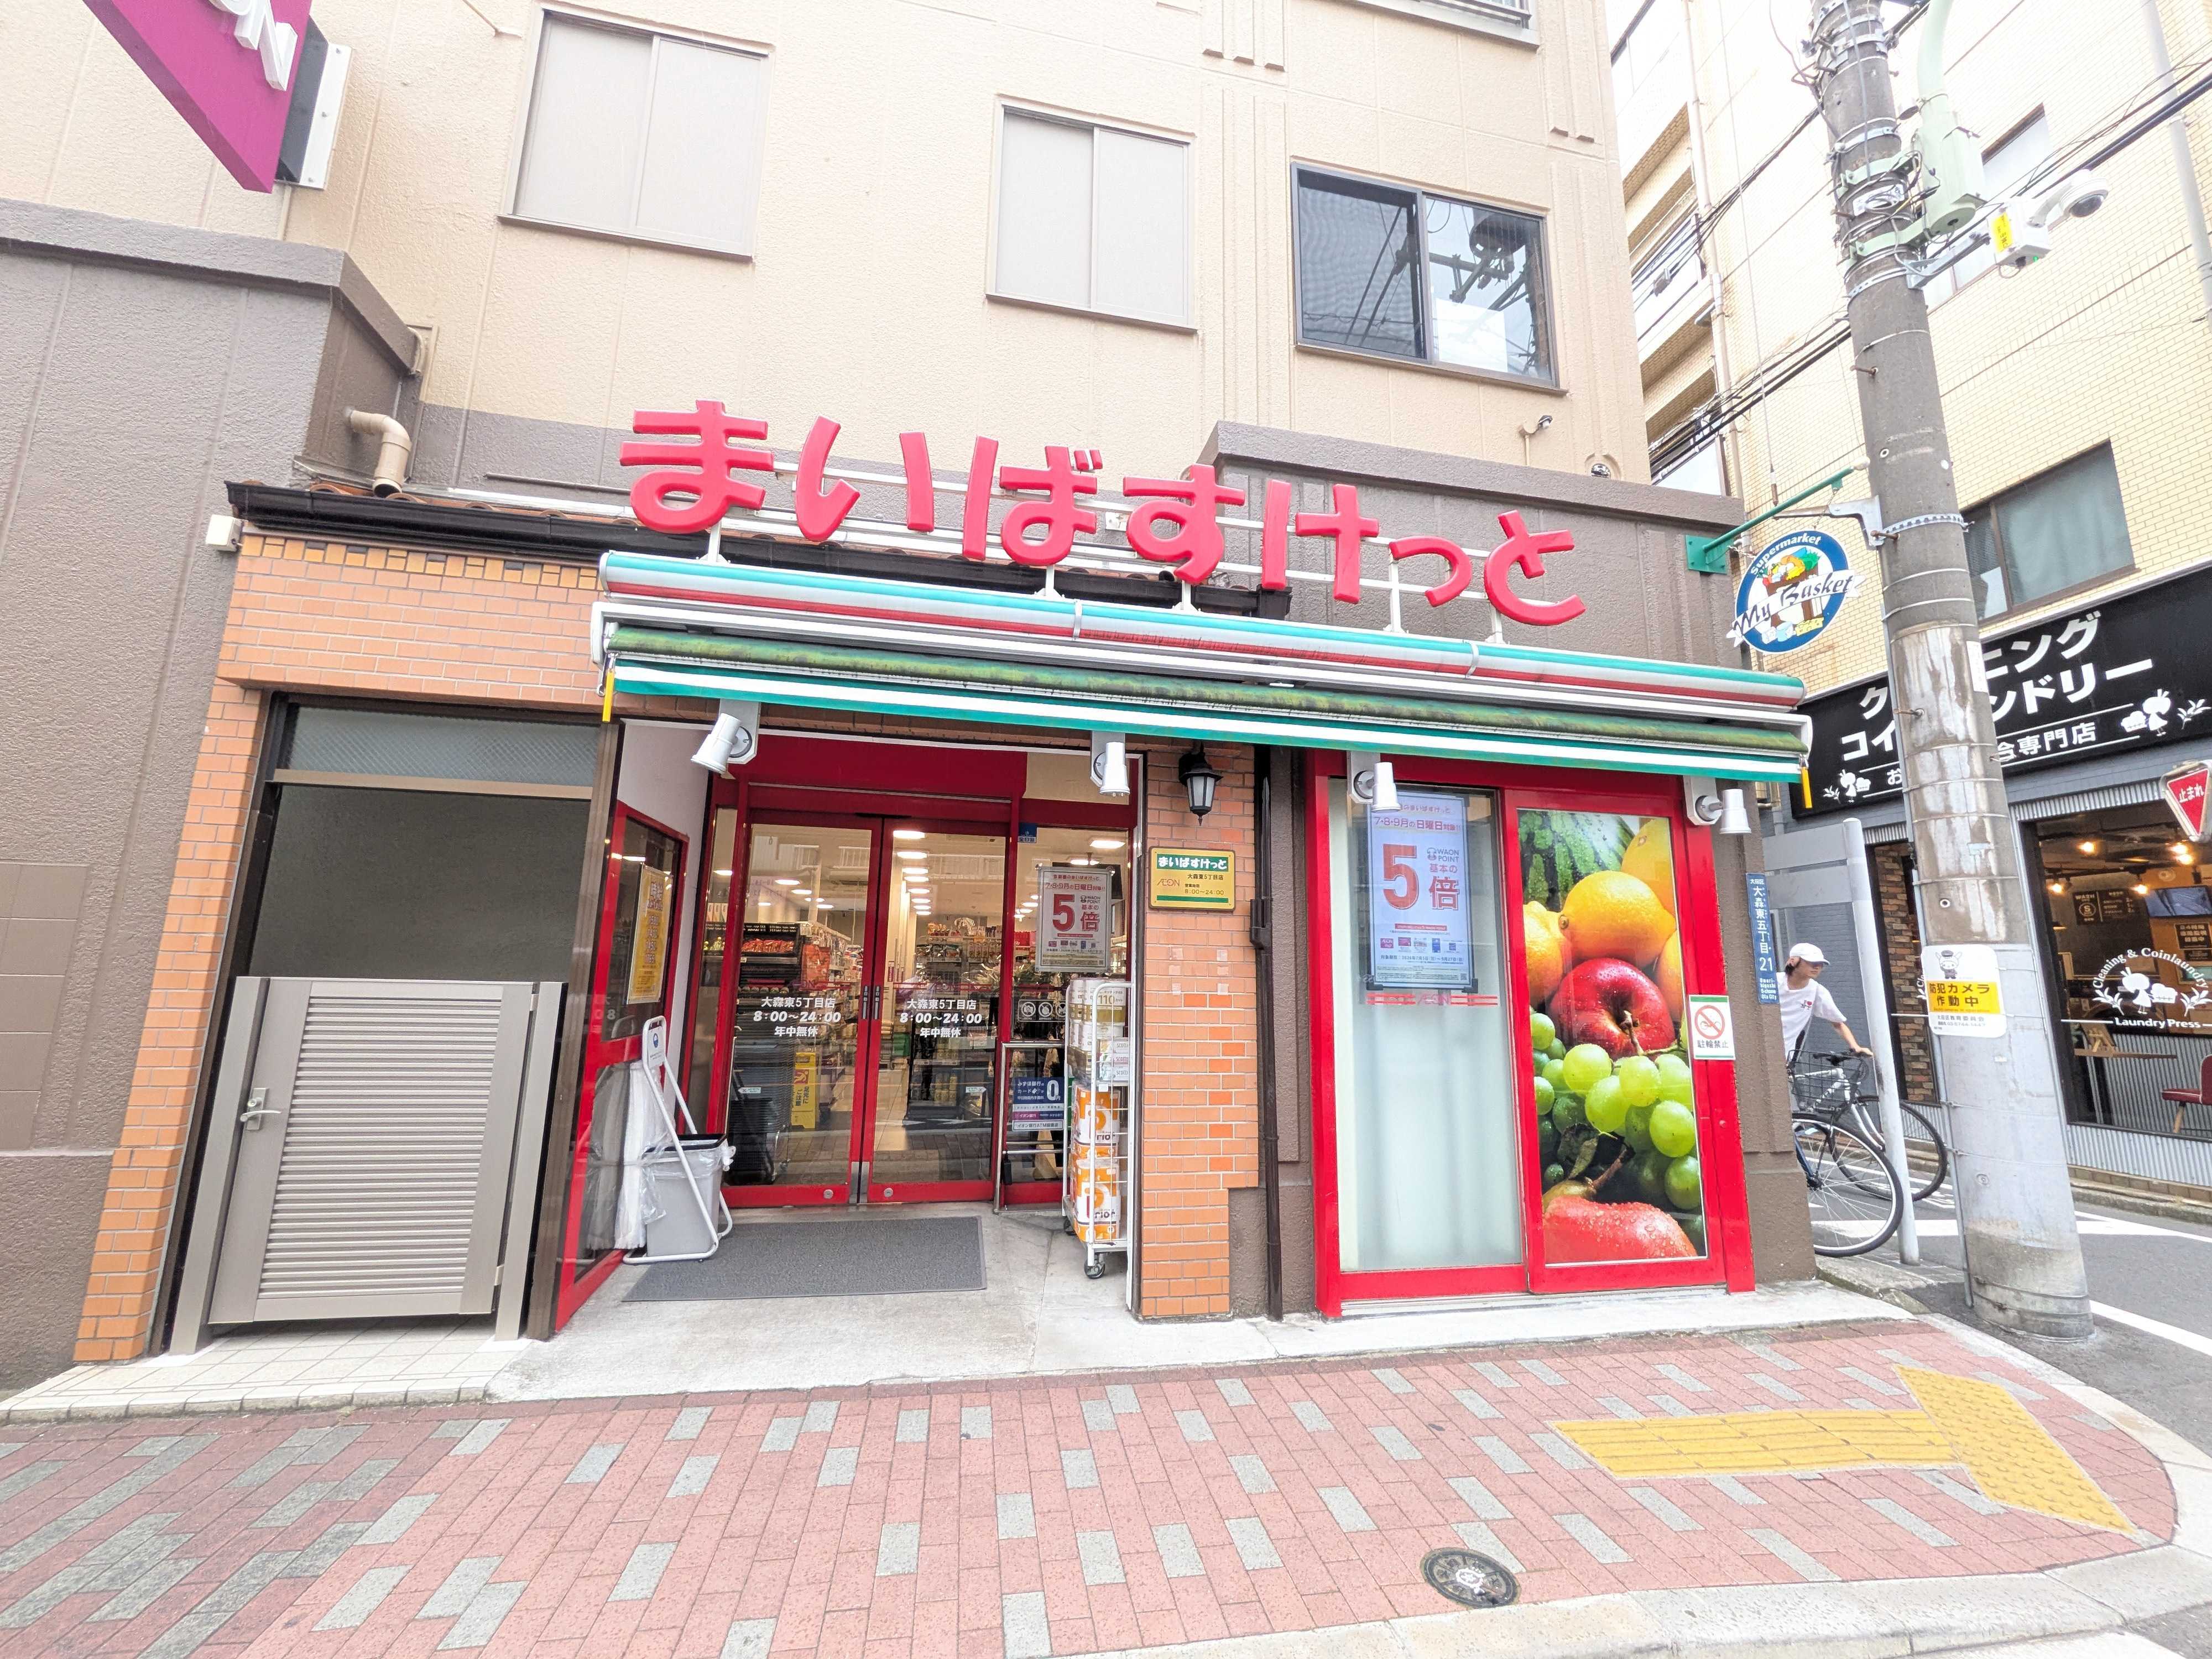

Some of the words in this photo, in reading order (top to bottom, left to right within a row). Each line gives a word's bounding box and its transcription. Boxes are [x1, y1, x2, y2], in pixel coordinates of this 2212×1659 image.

[620, 400, 1585, 625] まいばすけっと
[1750, 533, 1822, 576] Supermarket
[1732, 602, 1771, 635] My
[1780, 572, 1853, 606] Basket
[2179, 783, 2204, 803] 止まれ
[1159, 857, 1227, 870] まいばすけっと
[1430, 863, 1457, 873] 基本の
[1383, 843, 1419, 910] 5
[1429, 876, 1459, 910] 倍
[1052, 894, 1075, 932] 5
[1753, 886, 1768, 953] 大森東五丁目
[1081, 912, 1100, 931] 倍
[1760, 957, 1773, 971] 21
[2093, 954, 2126, 988] Cleaning
[2127, 949, 2138, 958] &
[2141, 947, 2209, 988] Coinlaundry
[1929, 983, 1990, 994] 防犯カメラ
[761, 996, 836, 1009] 大森東5丁目店
[907, 999, 977, 1010] 大森東5丁目店
[1098, 995, 1115, 1005] 110
[1937, 995, 1979, 1006] 作動中
[2115, 1017, 2165, 1029] Laundry
[2167, 1019, 2201, 1028] Press
[774, 1026, 818, 1037] 年中無休
[920, 1027, 961, 1038] 年中無休
[1697, 1040, 1729, 1048] 駐輪禁止
